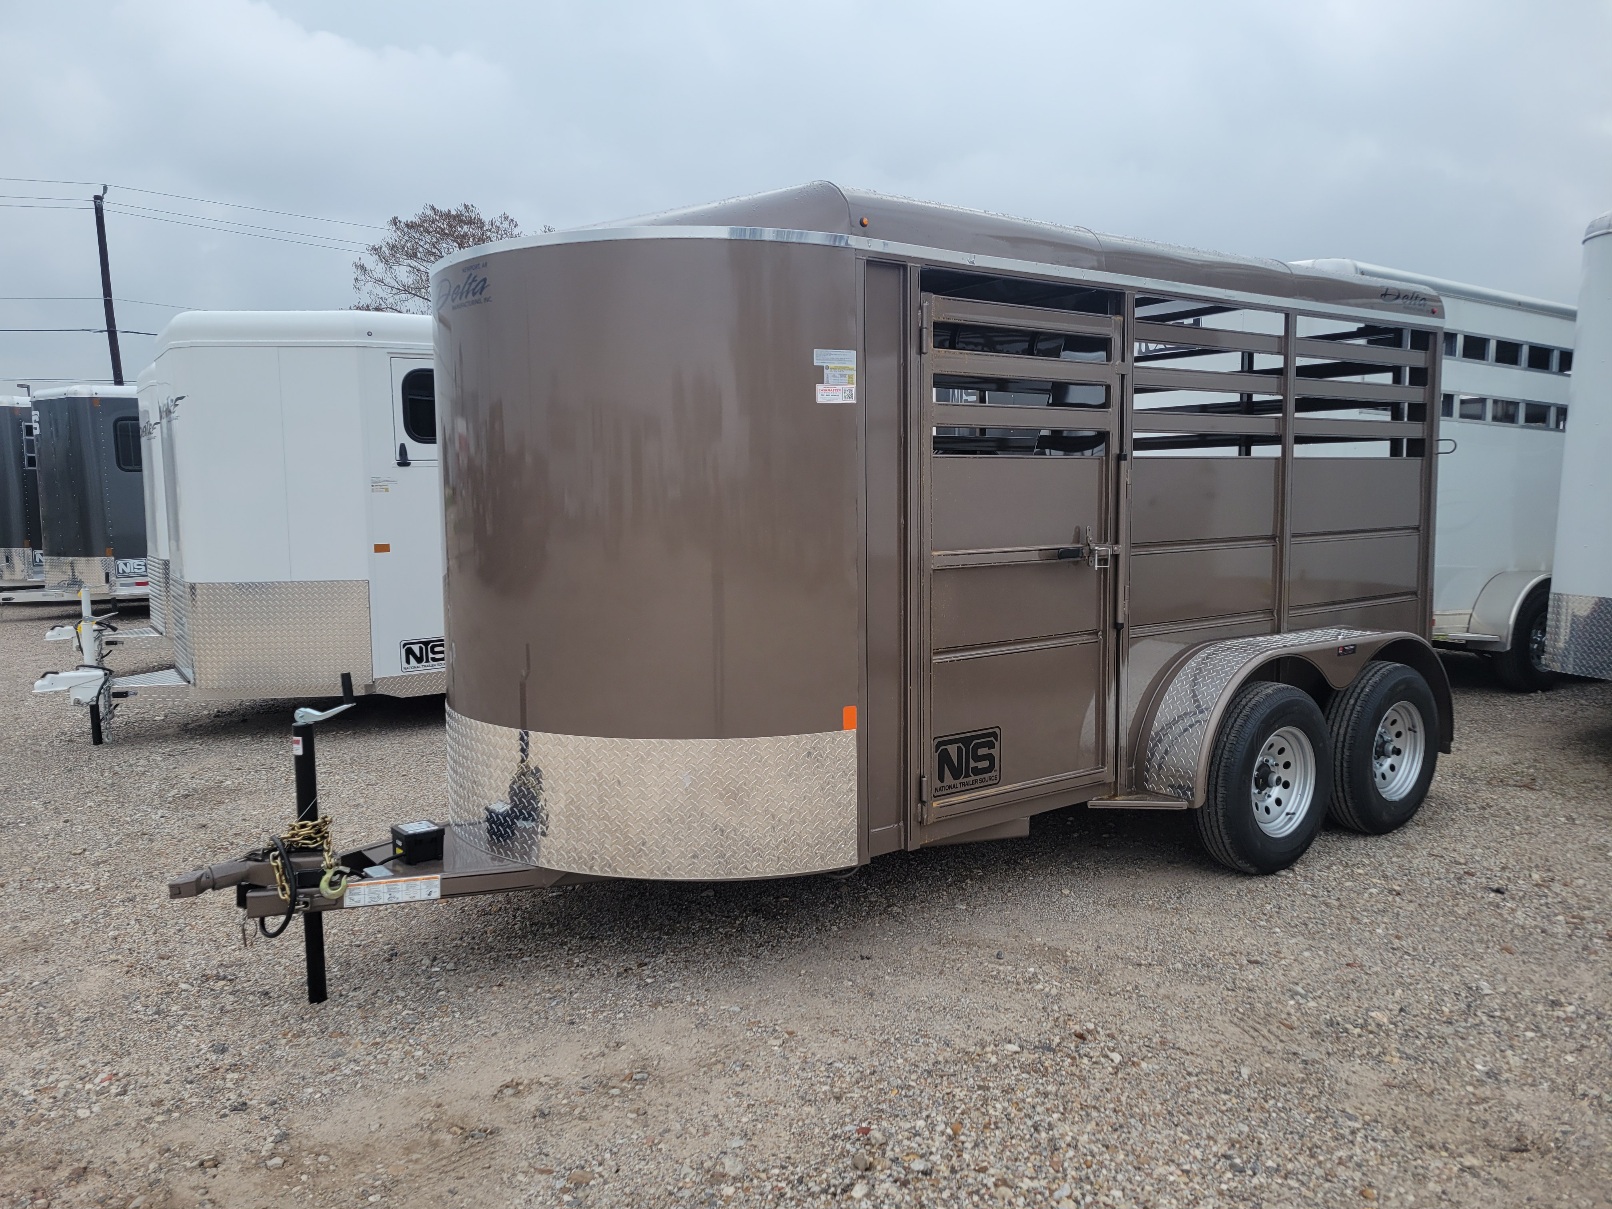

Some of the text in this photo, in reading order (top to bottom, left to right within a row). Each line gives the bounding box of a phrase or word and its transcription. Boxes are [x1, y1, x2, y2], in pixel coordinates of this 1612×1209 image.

[436, 272, 490, 311] Delta
[1380, 287, 1428, 307] Delta
[117, 560, 146, 574] NTS
[935, 731, 998, 783] NTS
[935, 783, 958, 793] NATIONAL
[979, 774, 998, 783] SOURCE
